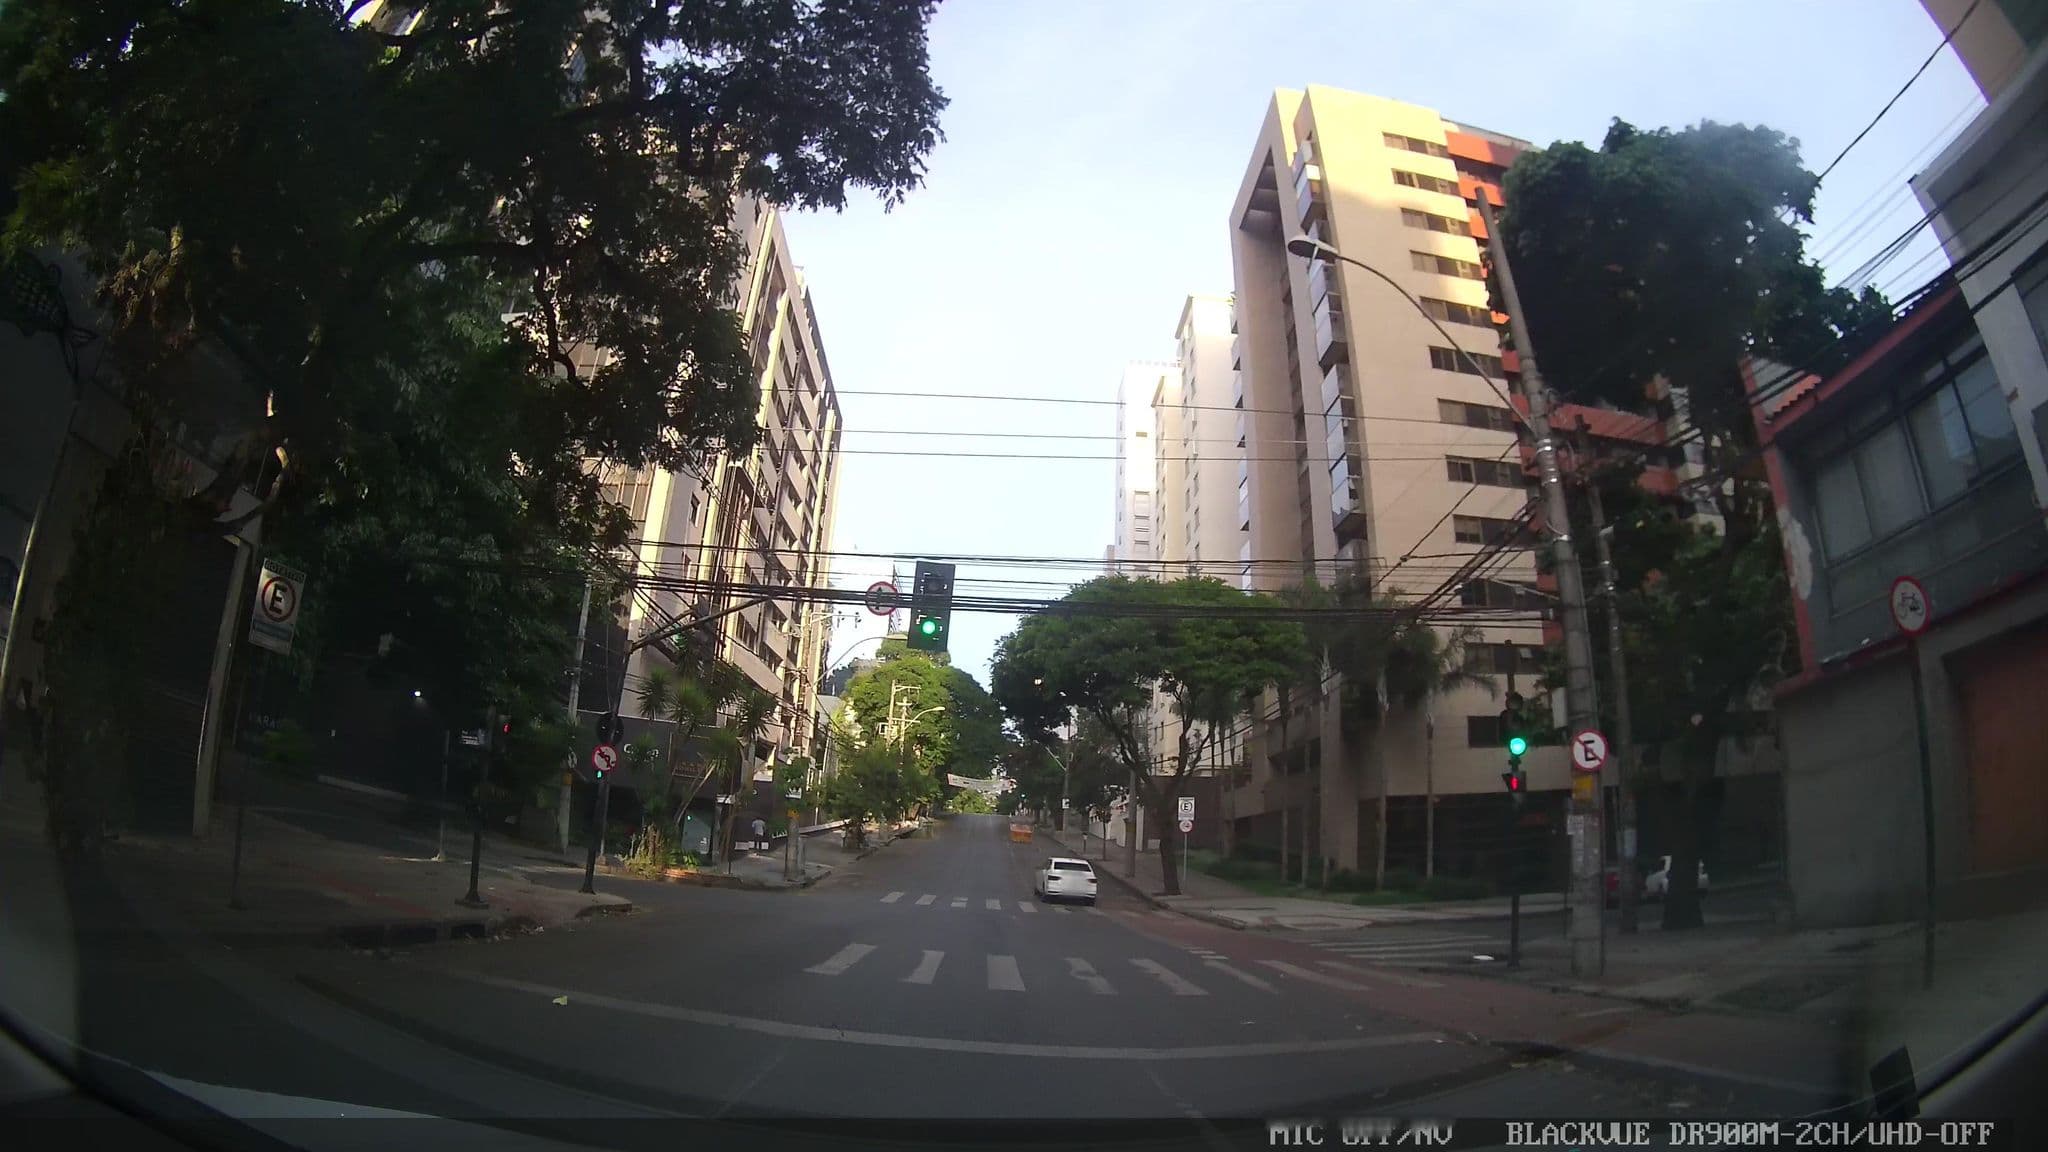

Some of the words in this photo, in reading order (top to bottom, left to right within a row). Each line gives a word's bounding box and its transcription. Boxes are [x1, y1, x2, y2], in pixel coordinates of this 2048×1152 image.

[269, 583, 288, 615] E
[1583, 740, 1597, 762] E
[1183, 802, 1189, 811] E
